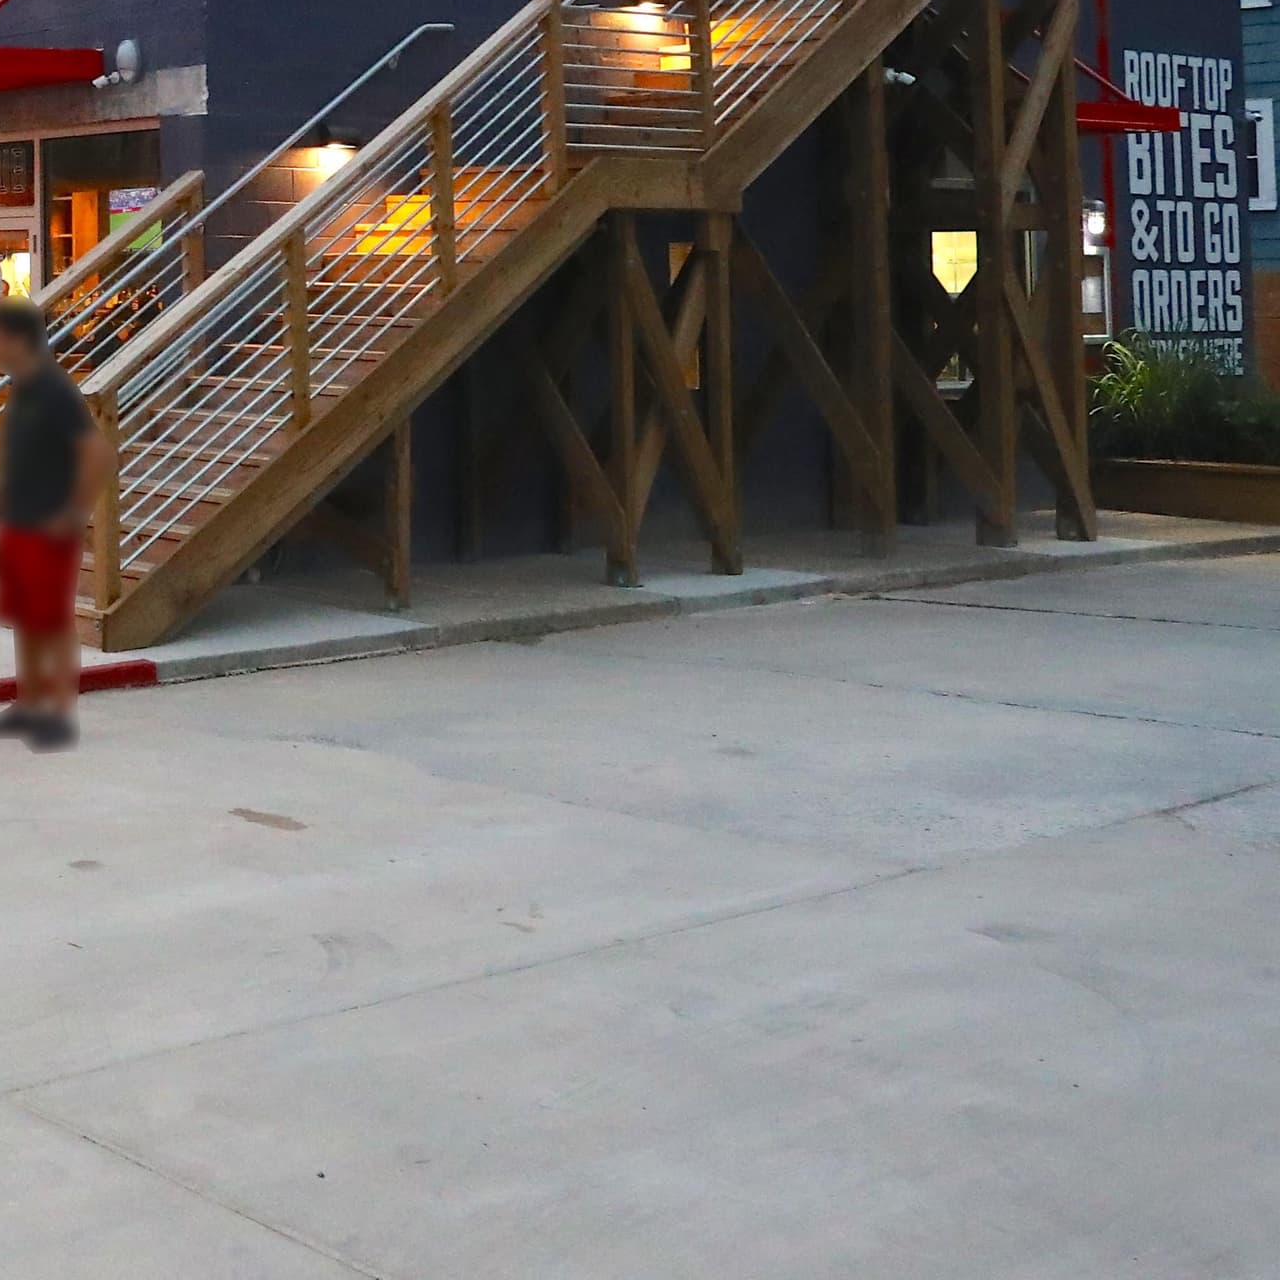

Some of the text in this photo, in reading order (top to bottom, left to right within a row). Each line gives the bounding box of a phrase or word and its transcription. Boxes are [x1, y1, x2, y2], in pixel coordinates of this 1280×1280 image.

[1124, 50, 1233, 113] ROOFTOP
[1126, 112, 1238, 198] BITES
[1203, 202, 1240, 264] GO
[1132, 269, 1243, 333] ORDERS
